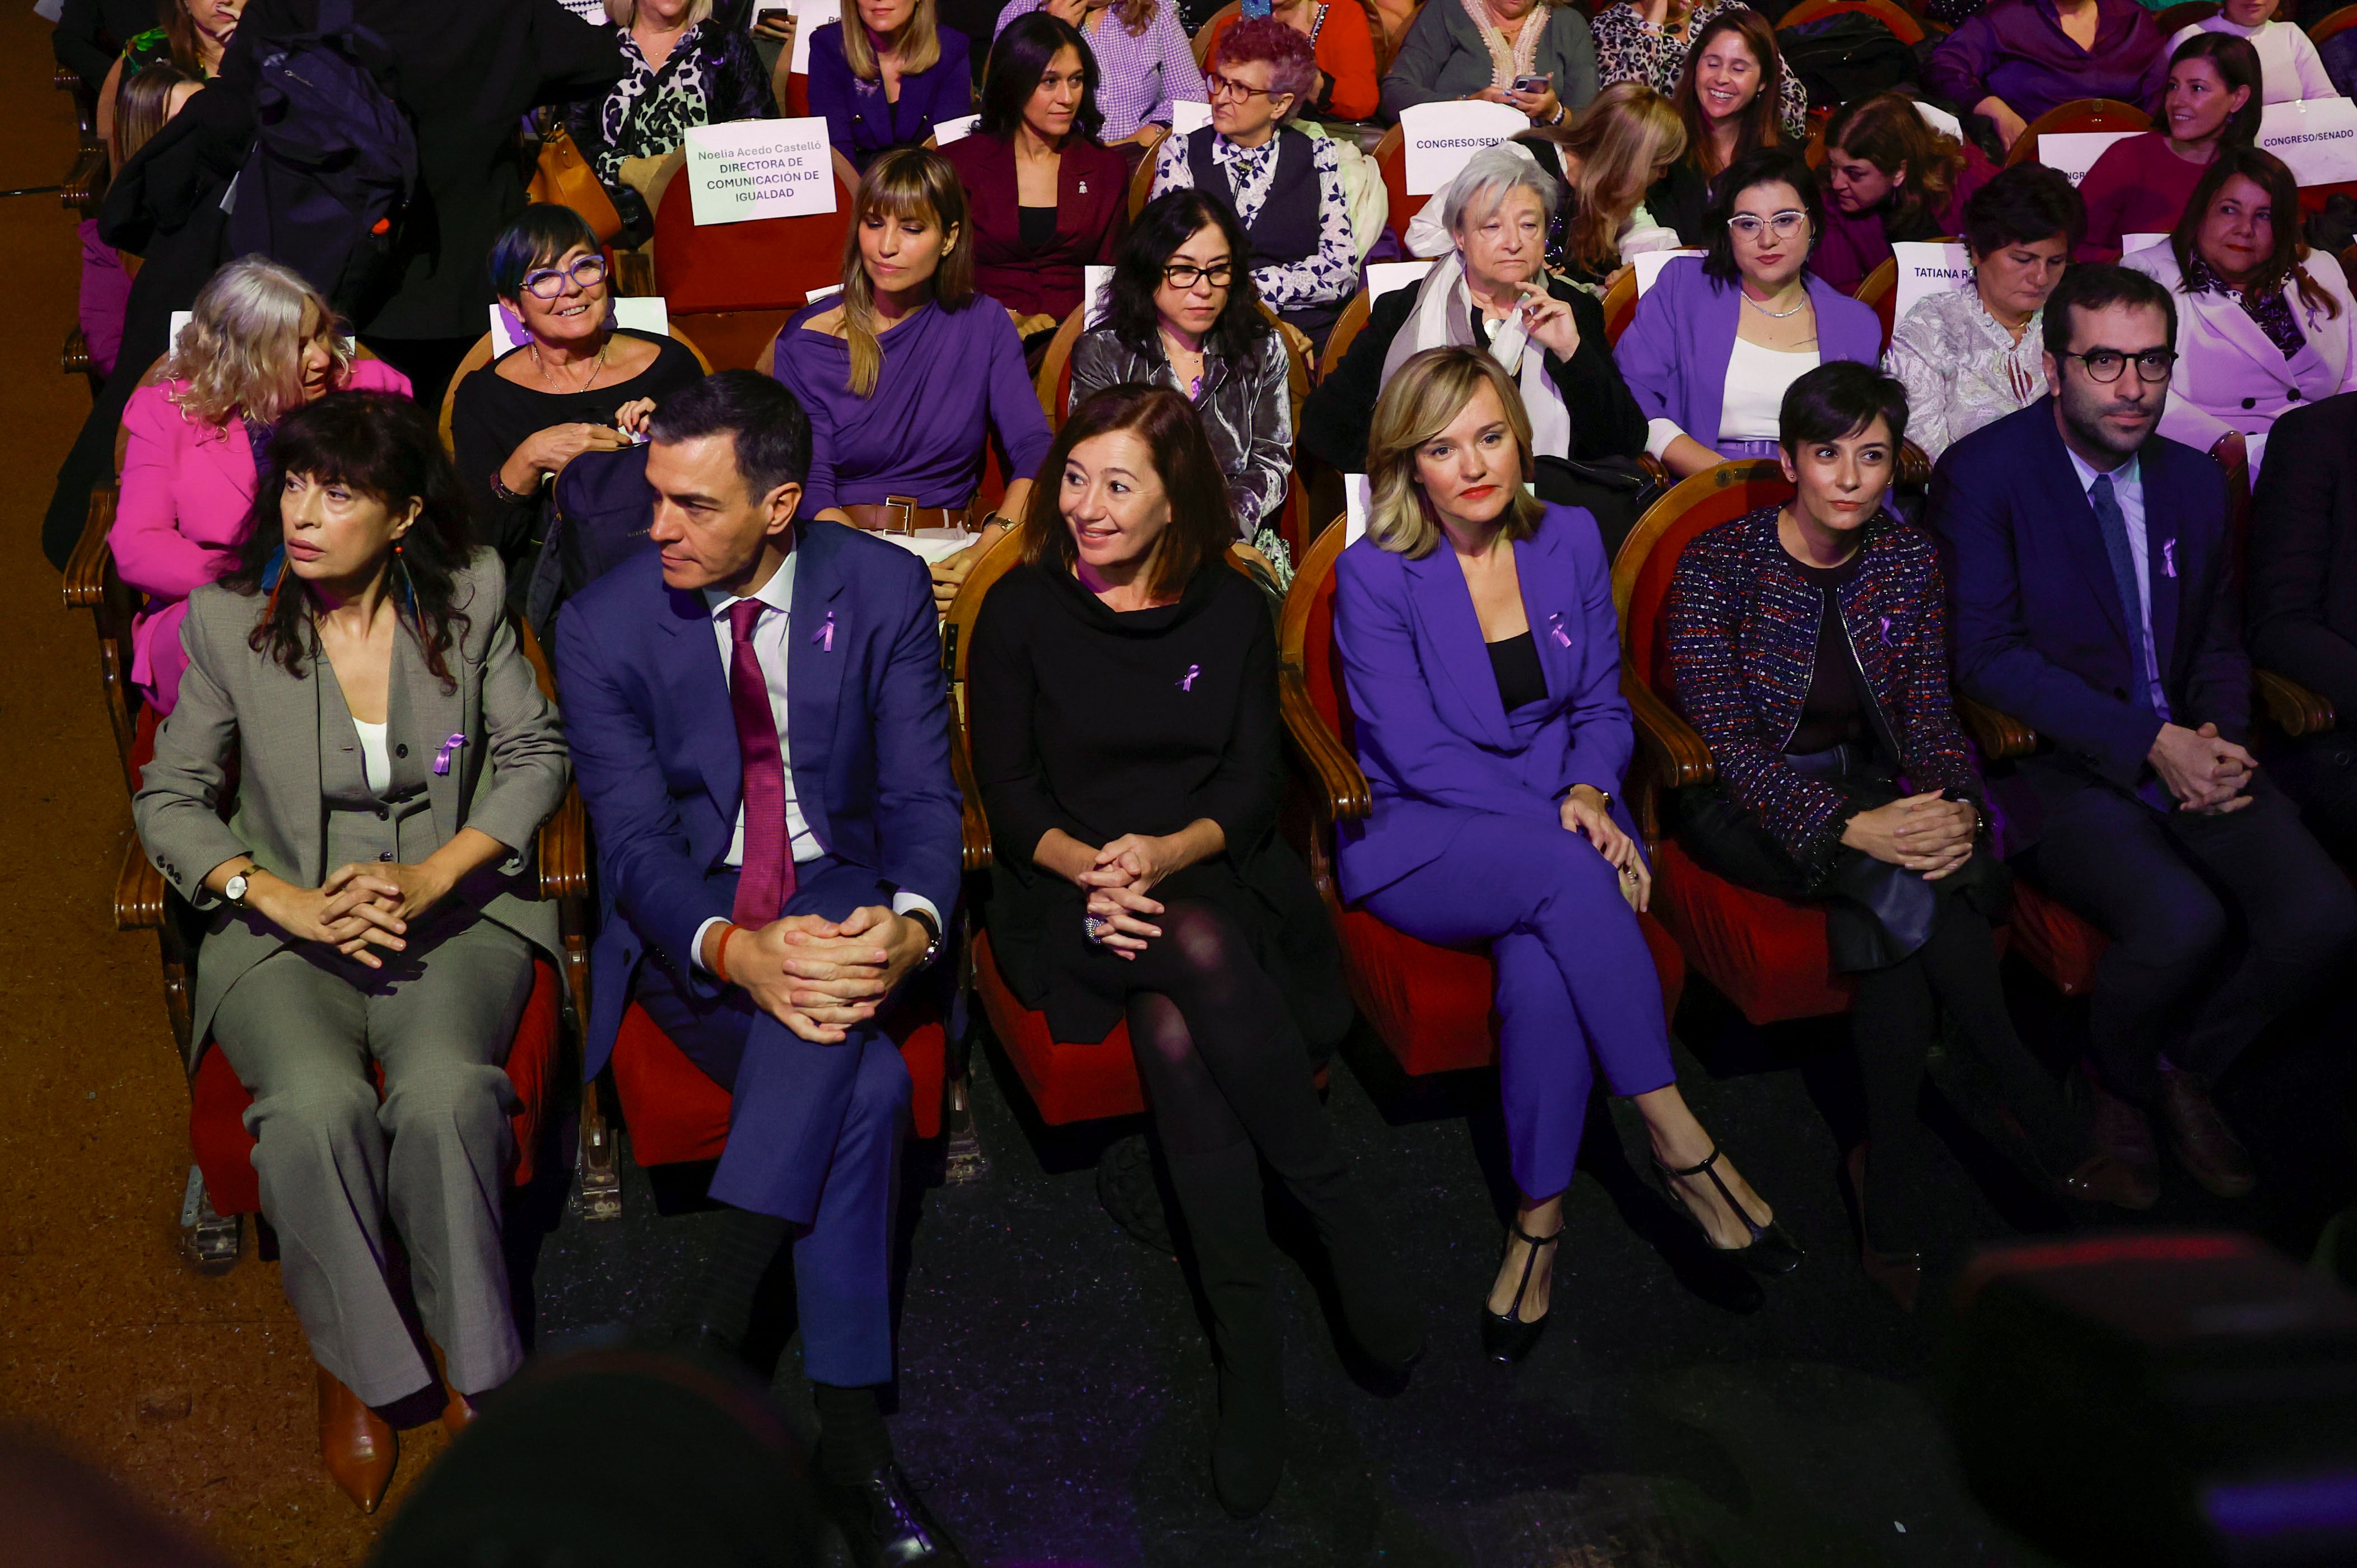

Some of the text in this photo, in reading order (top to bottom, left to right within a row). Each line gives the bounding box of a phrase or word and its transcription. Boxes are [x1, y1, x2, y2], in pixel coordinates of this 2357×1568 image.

[1417, 137, 1511, 149] CONGRESO/SENA
[2264, 129, 2354, 147] CONGRESO/SENADO
[698, 141, 821, 161] Noelia Acedo Castelló
[720, 157, 803, 174] DIRECTORA DE
[707, 171, 819, 190] COMUNICACIÓN DE
[736, 188, 794, 202] IGUALDAD
[1914, 267, 1959, 279] TATIANA
